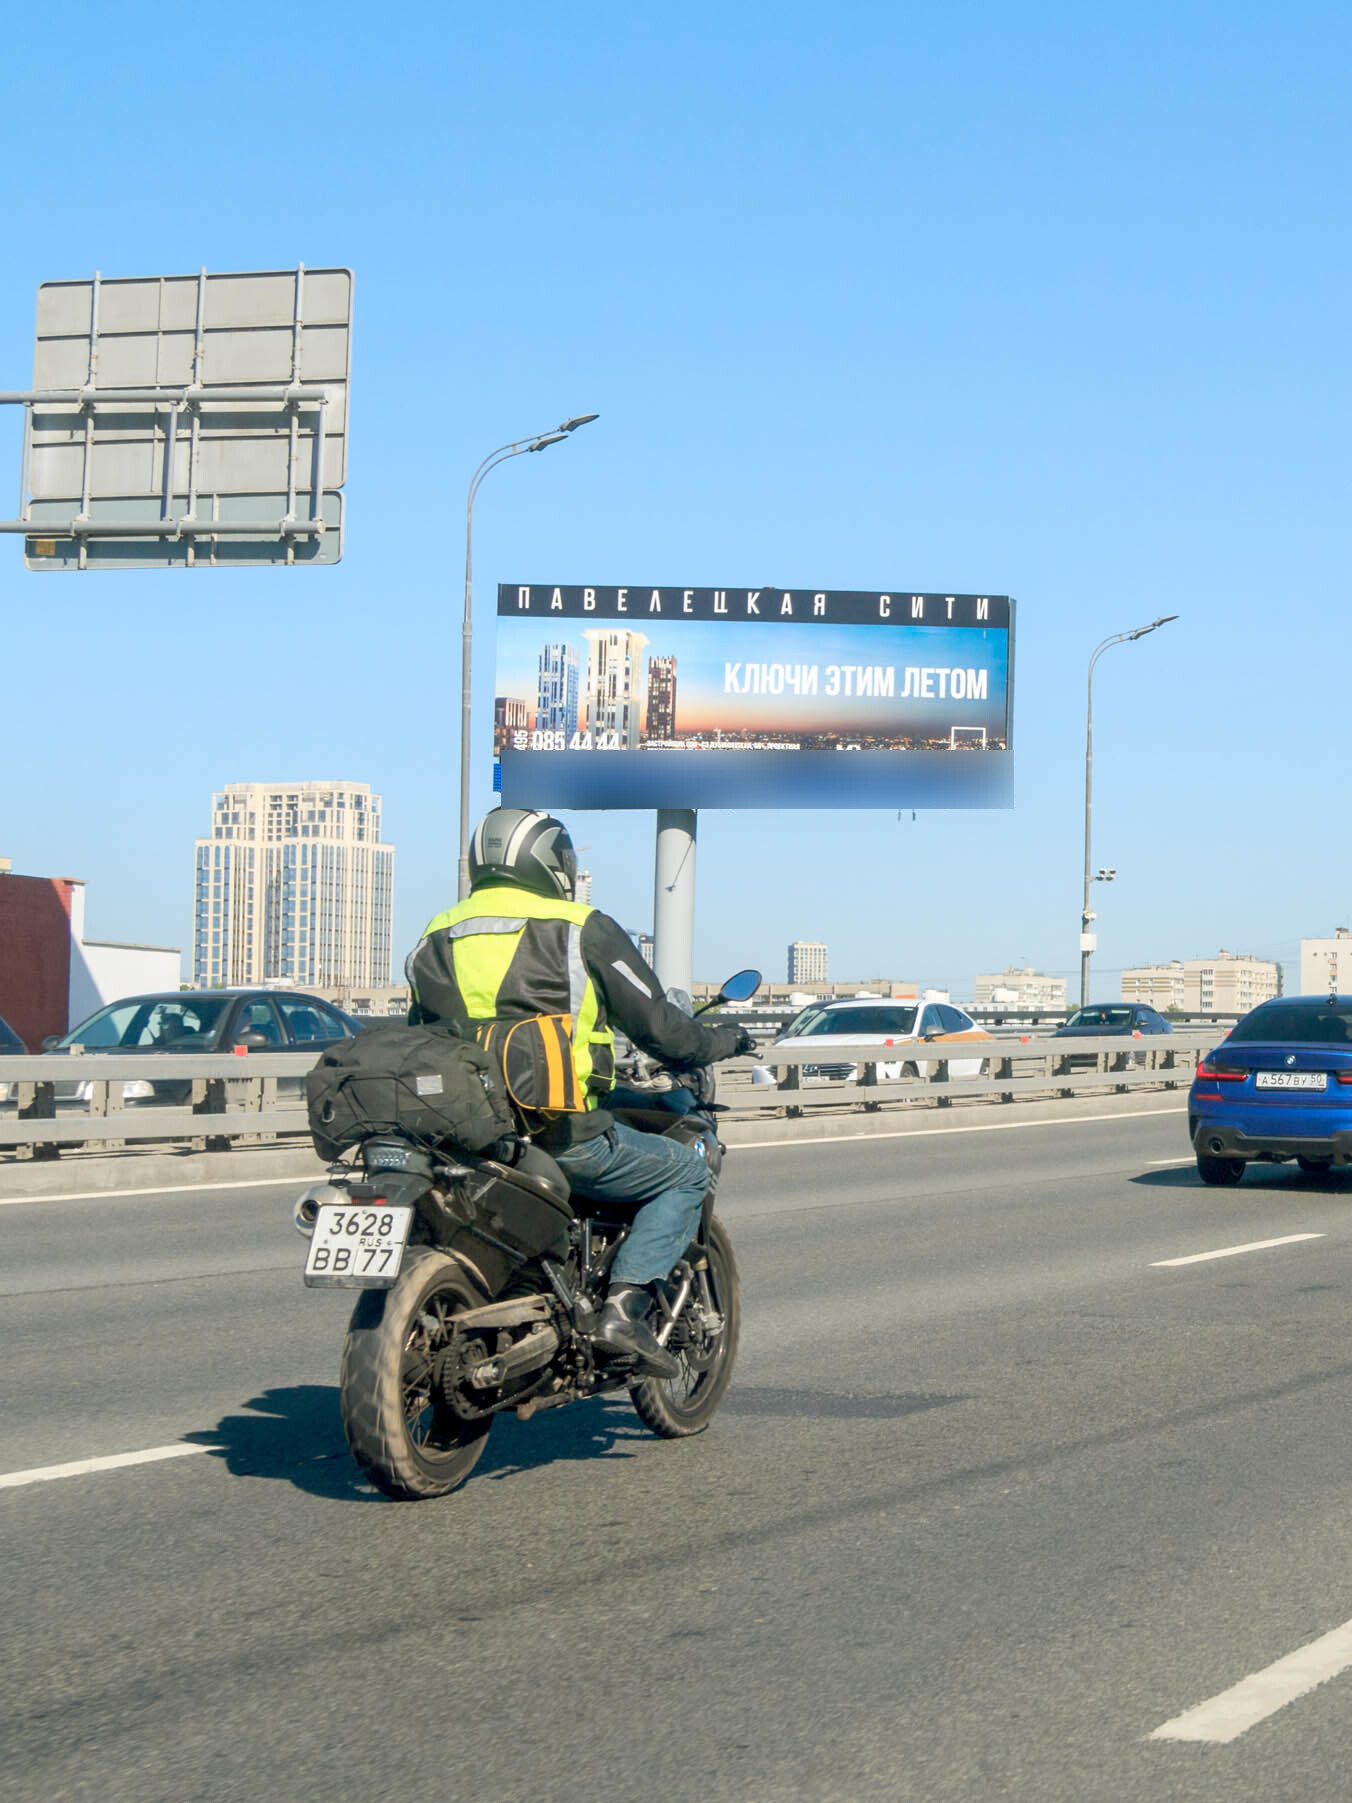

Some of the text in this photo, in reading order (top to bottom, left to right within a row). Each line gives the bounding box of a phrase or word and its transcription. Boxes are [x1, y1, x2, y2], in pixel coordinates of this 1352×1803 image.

[518, 586, 989, 620] ПАВЕЛЕЦКАЯ СИТИ
[723, 663, 988, 700] КЛЮЧИ ЭТИМ ЛЕТОМ
[329, 1212, 394, 1236] 3628
[359, 1238, 383, 1247] RUS
[362, 1249, 394, 1272] 77
